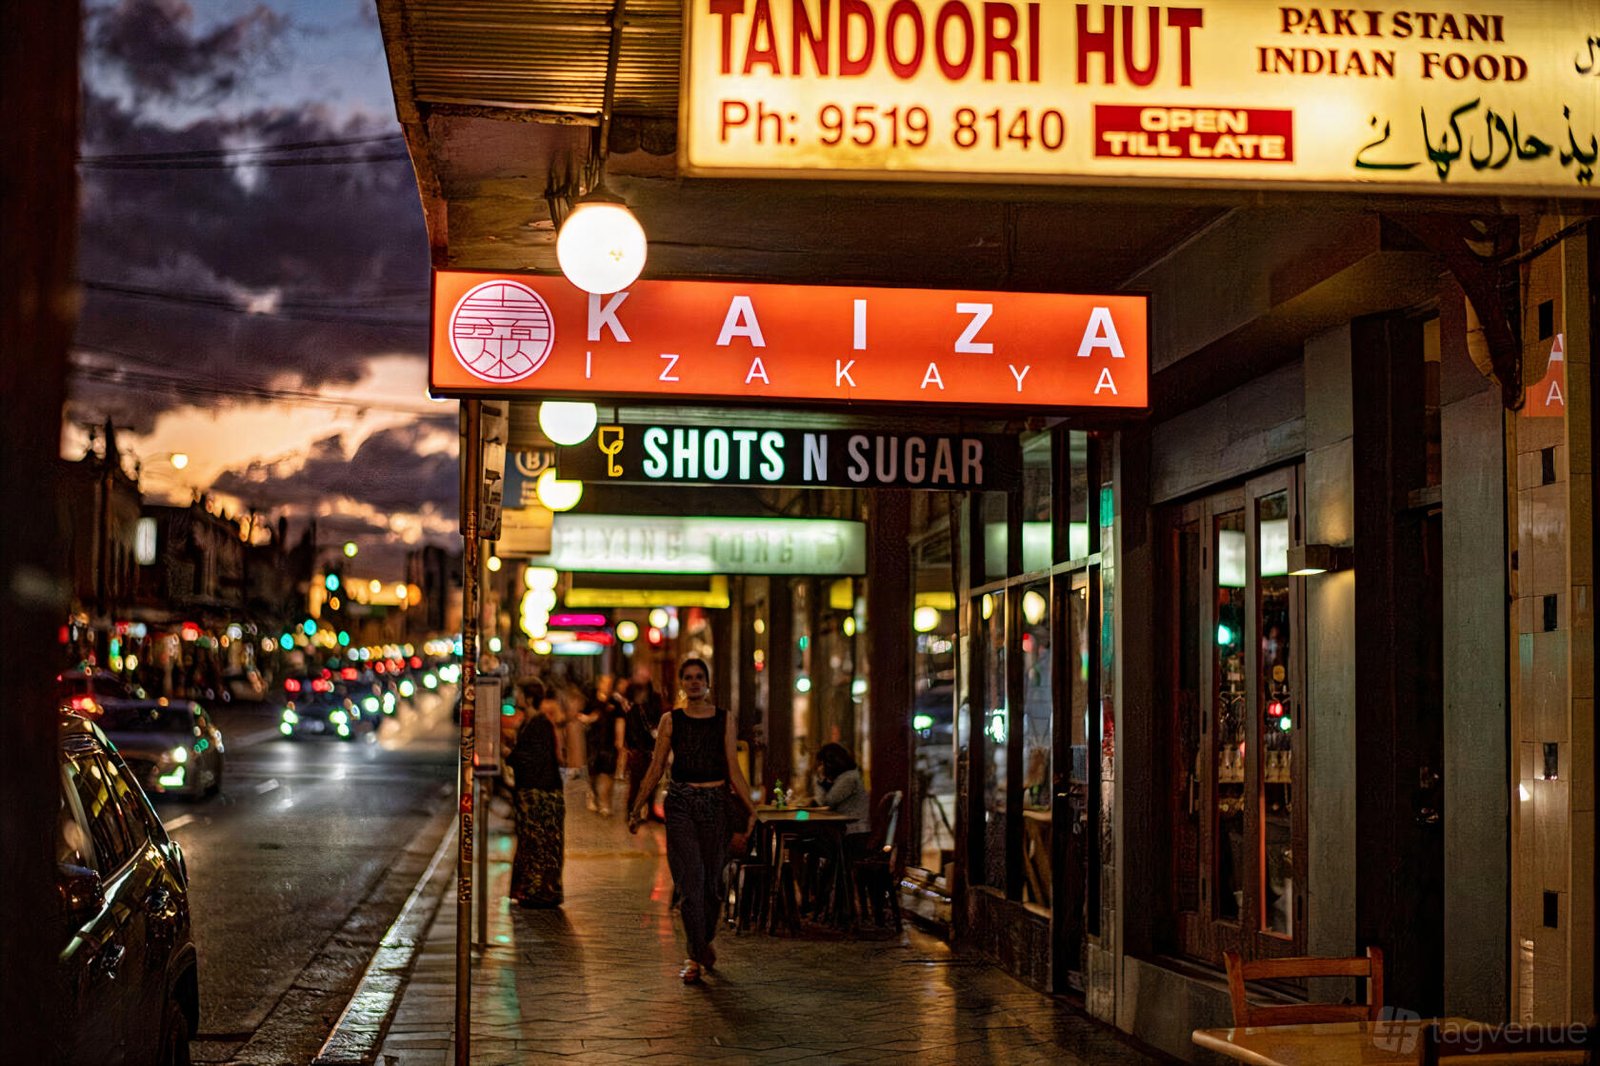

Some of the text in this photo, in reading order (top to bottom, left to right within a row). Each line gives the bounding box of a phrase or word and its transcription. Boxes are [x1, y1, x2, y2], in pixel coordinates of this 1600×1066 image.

[709, 0, 1203, 87] TANDOORI HUT
[1279, 7, 1505, 43] PAKISTANI
[1257, 46, 1528, 82] INDIAN FOOD
[720, 100, 1065, 151] Ph: 9519 8140
[1139, 108, 1248, 134] OPEN
[1102, 133, 1286, 160] TILL LATE
[586, 291, 1126, 358] KAIZA
[585, 350, 1119, 396] IZAKAYA
[642, 427, 984, 485] SHOTS N SUGAR
